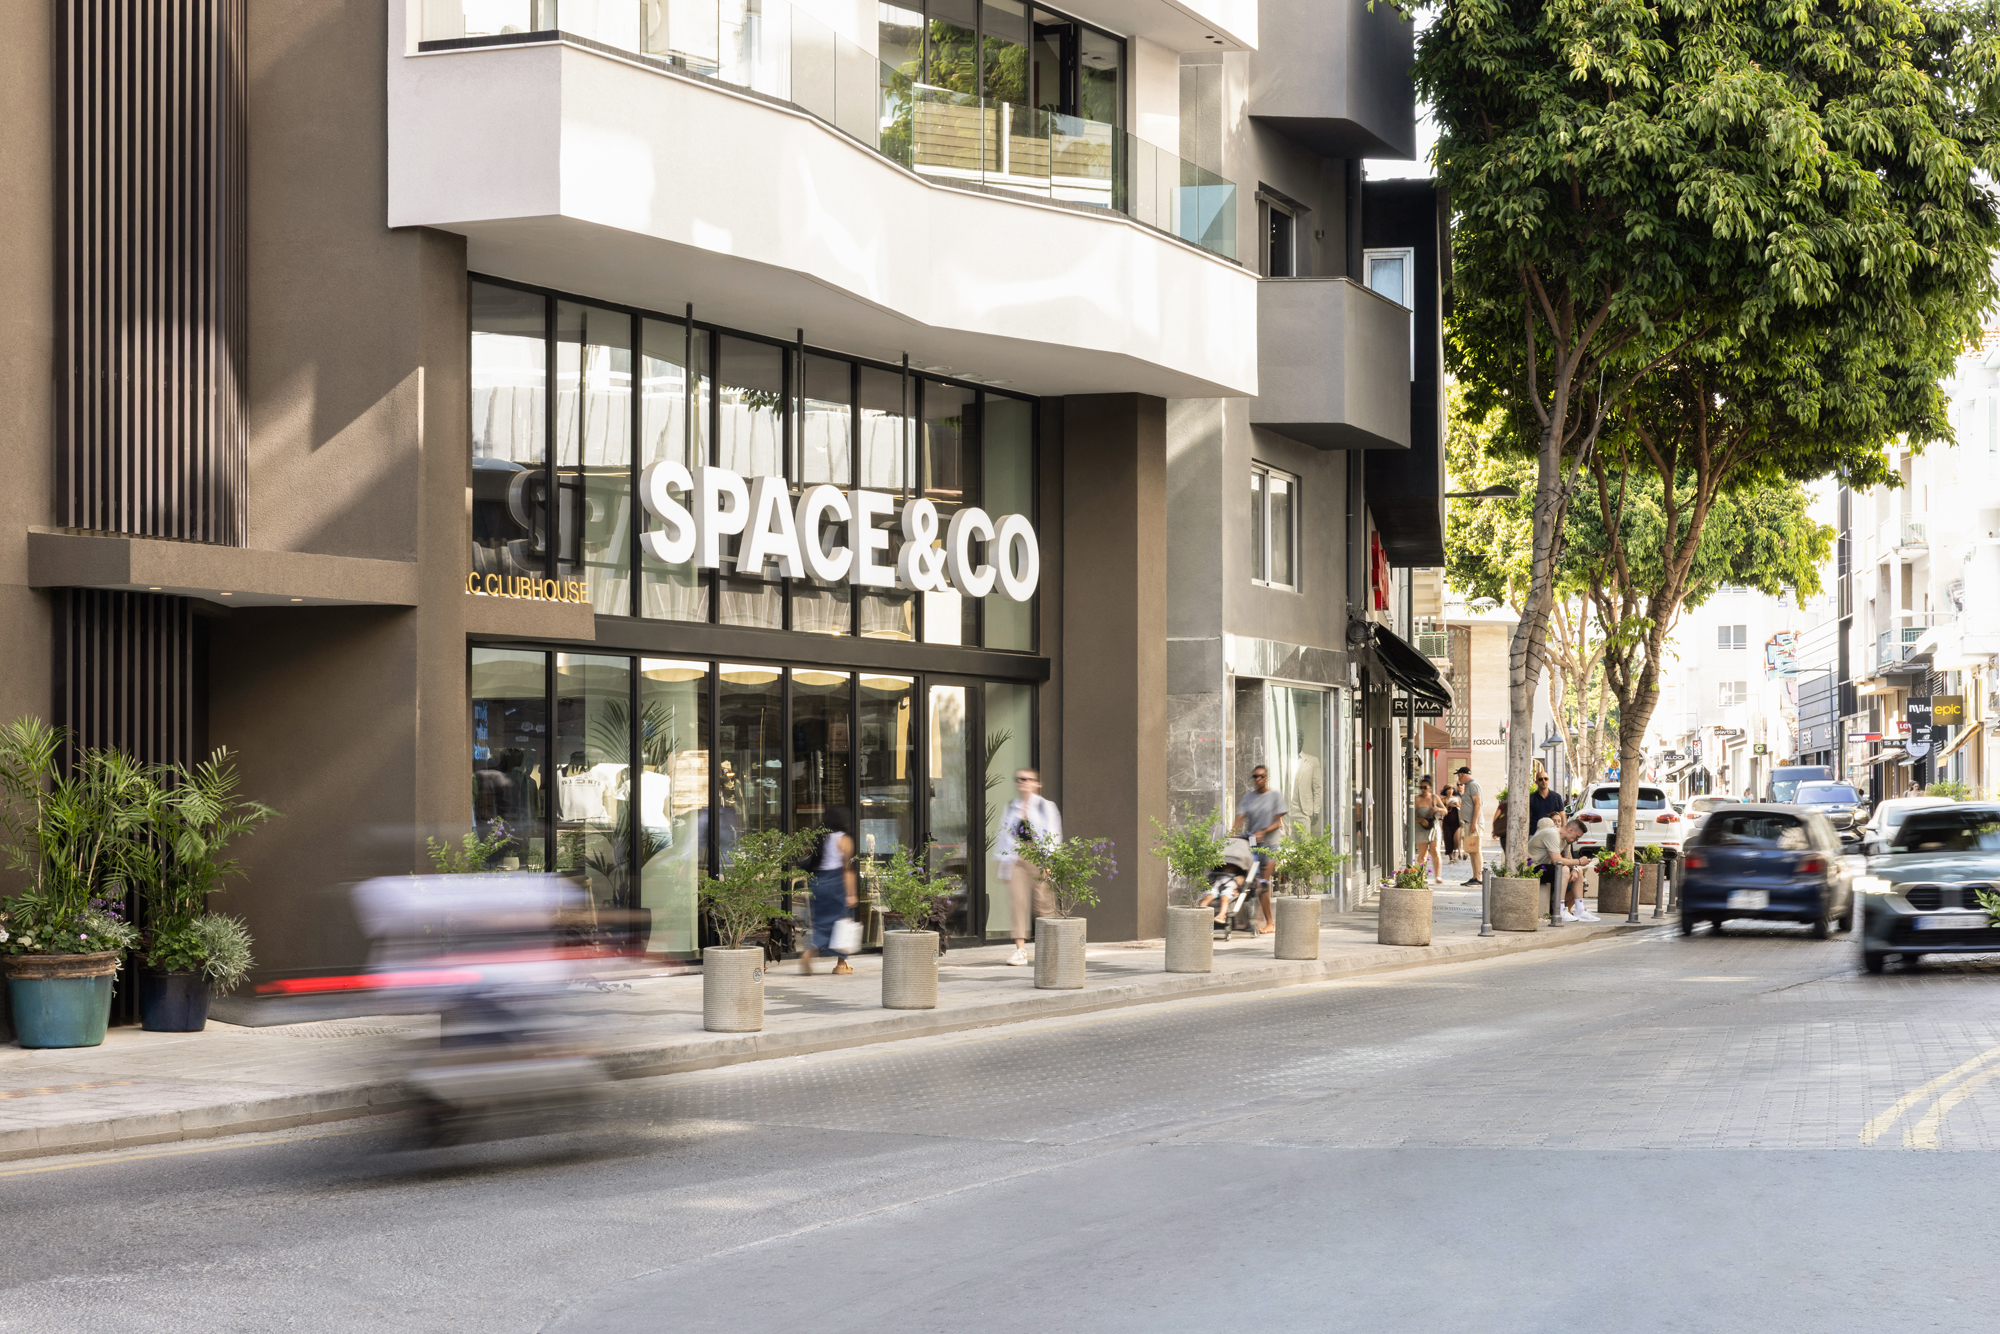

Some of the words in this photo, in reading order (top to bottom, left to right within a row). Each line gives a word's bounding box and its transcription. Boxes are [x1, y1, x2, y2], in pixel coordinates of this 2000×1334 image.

[640, 460, 1039, 602] SPACE&CO
[466, 572, 481, 594] C
[485, 573, 591, 604] CLUBHOUSE
[1934, 703, 1961, 716] epic
